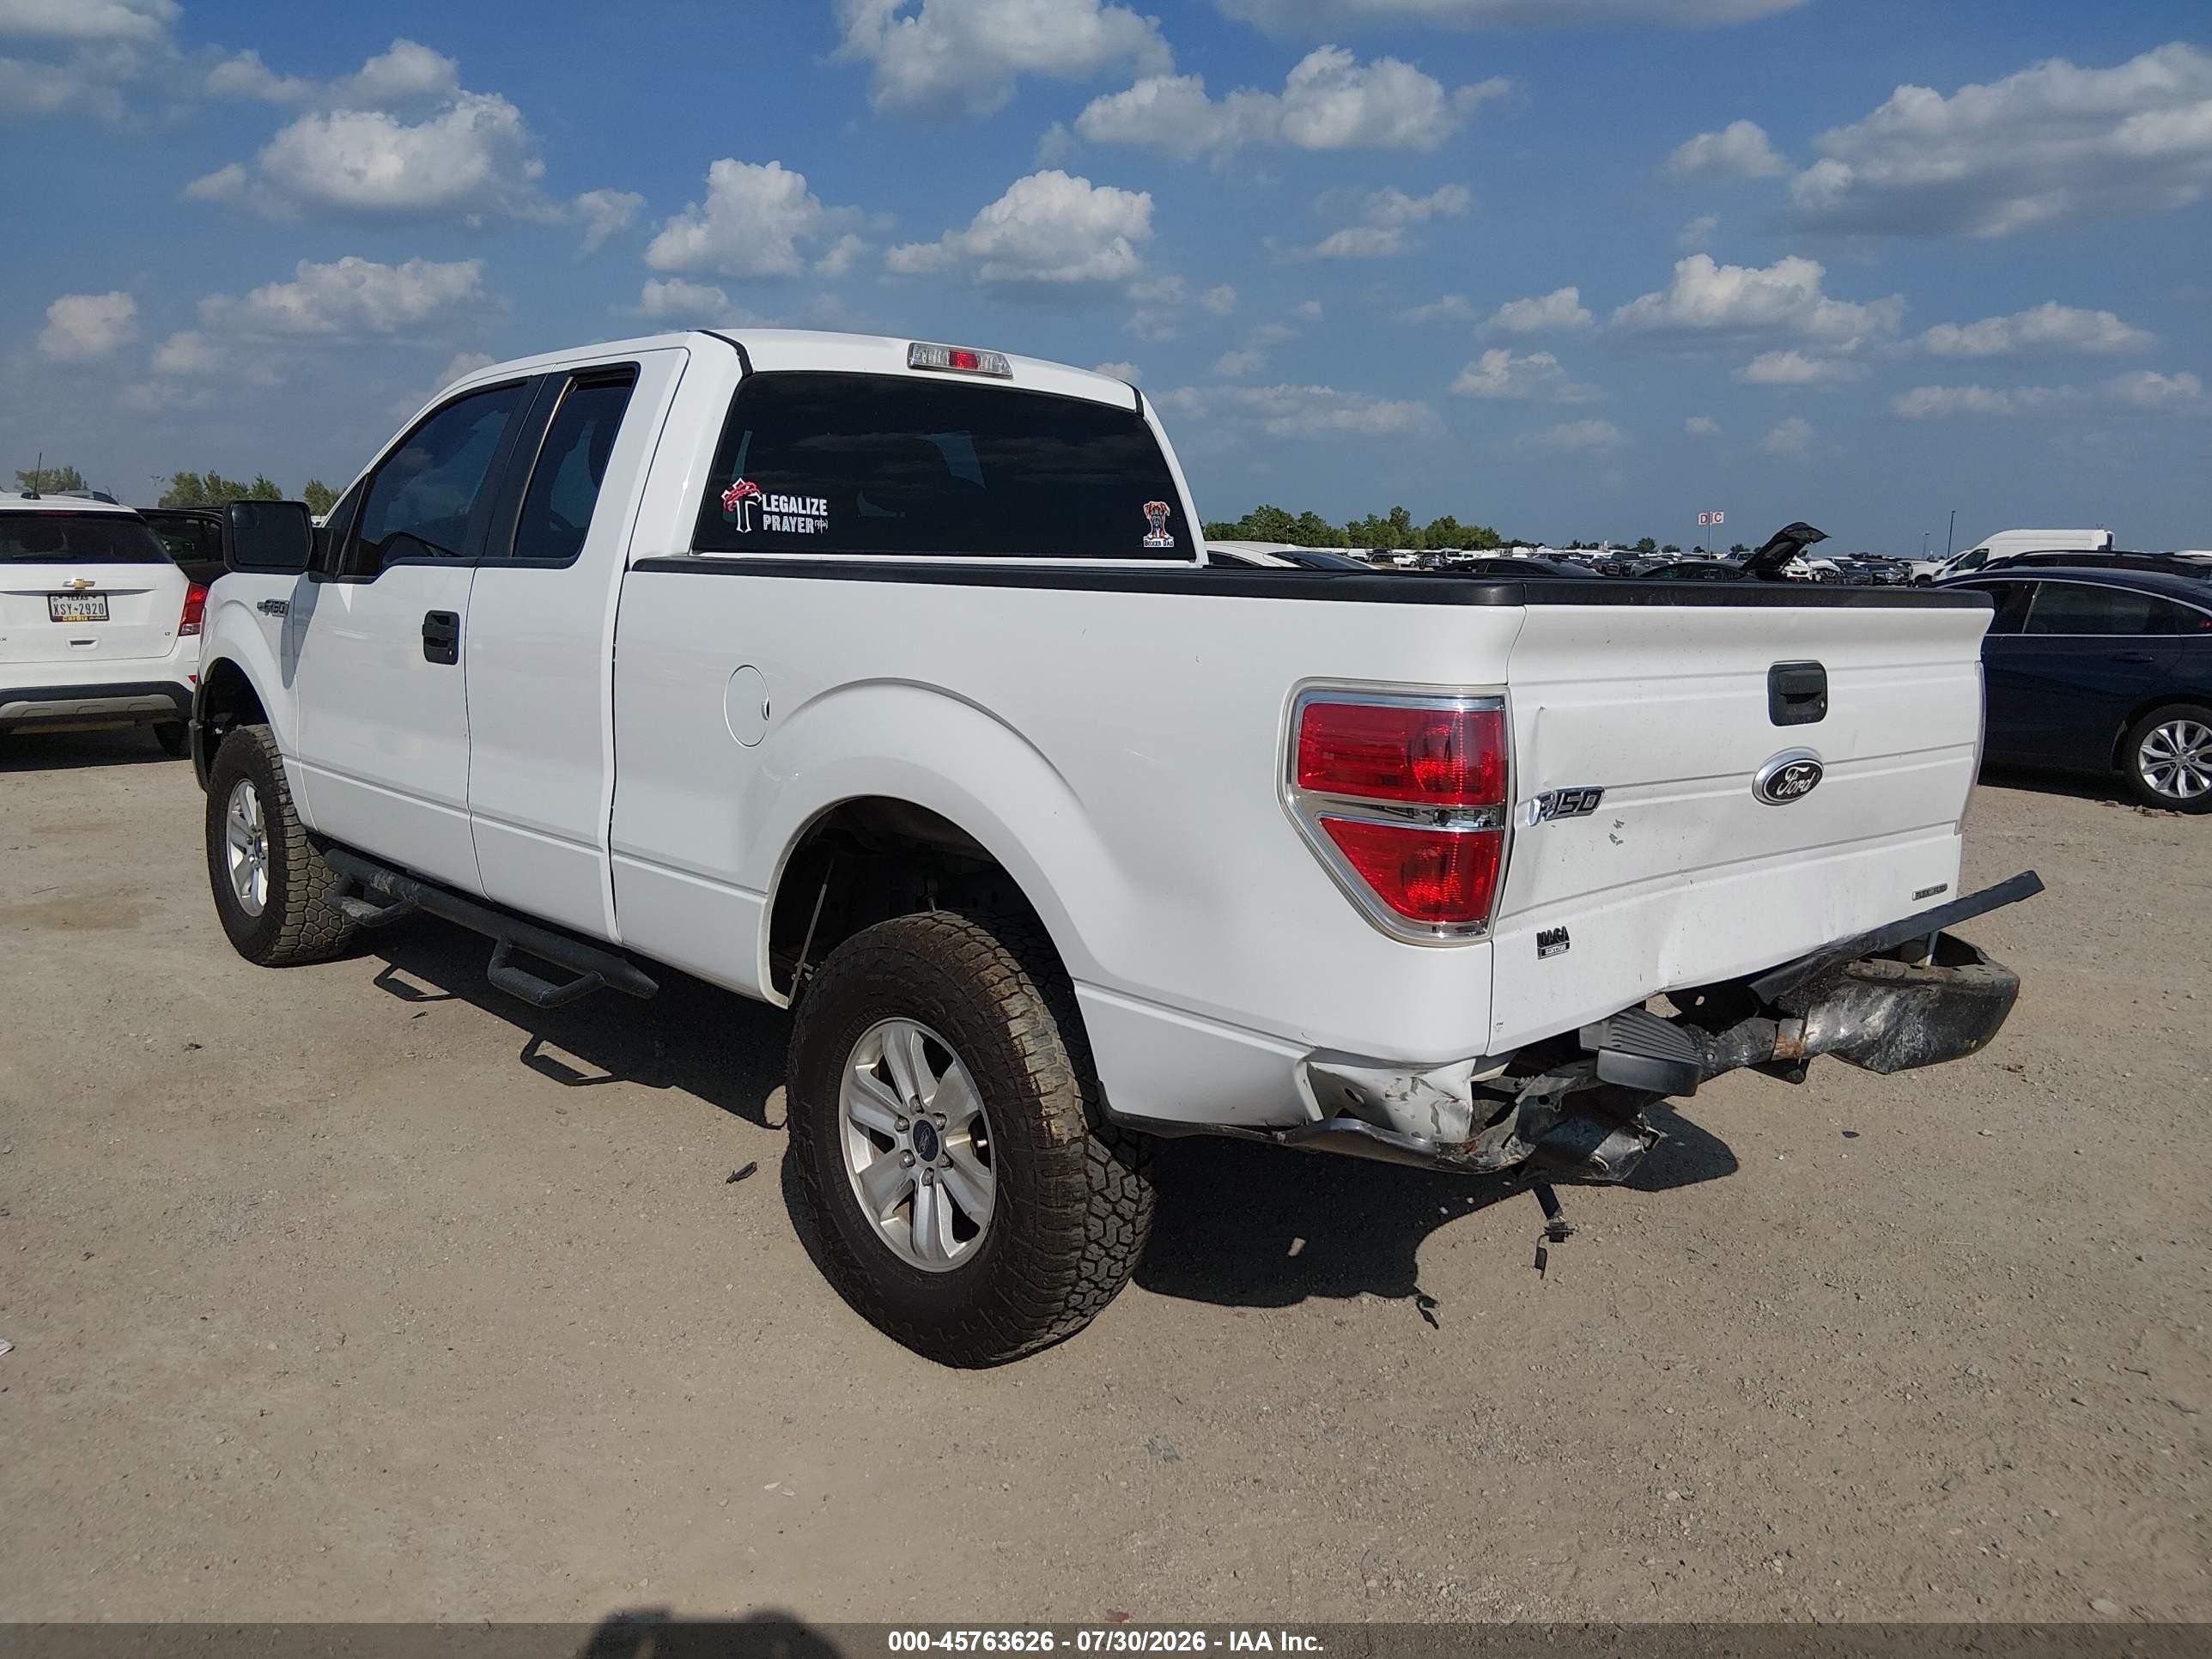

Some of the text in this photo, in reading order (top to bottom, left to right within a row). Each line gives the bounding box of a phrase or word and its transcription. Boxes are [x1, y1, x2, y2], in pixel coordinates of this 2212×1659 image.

[763, 494, 828, 515] LEGALIZE
[763, 514, 815, 533] PRAYER
[1701, 514, 1708, 523] D
[1715, 513, 1723, 522] C
[1776, 766, 1816, 796] Ford
[1536, 926, 1570, 948] MAGA
